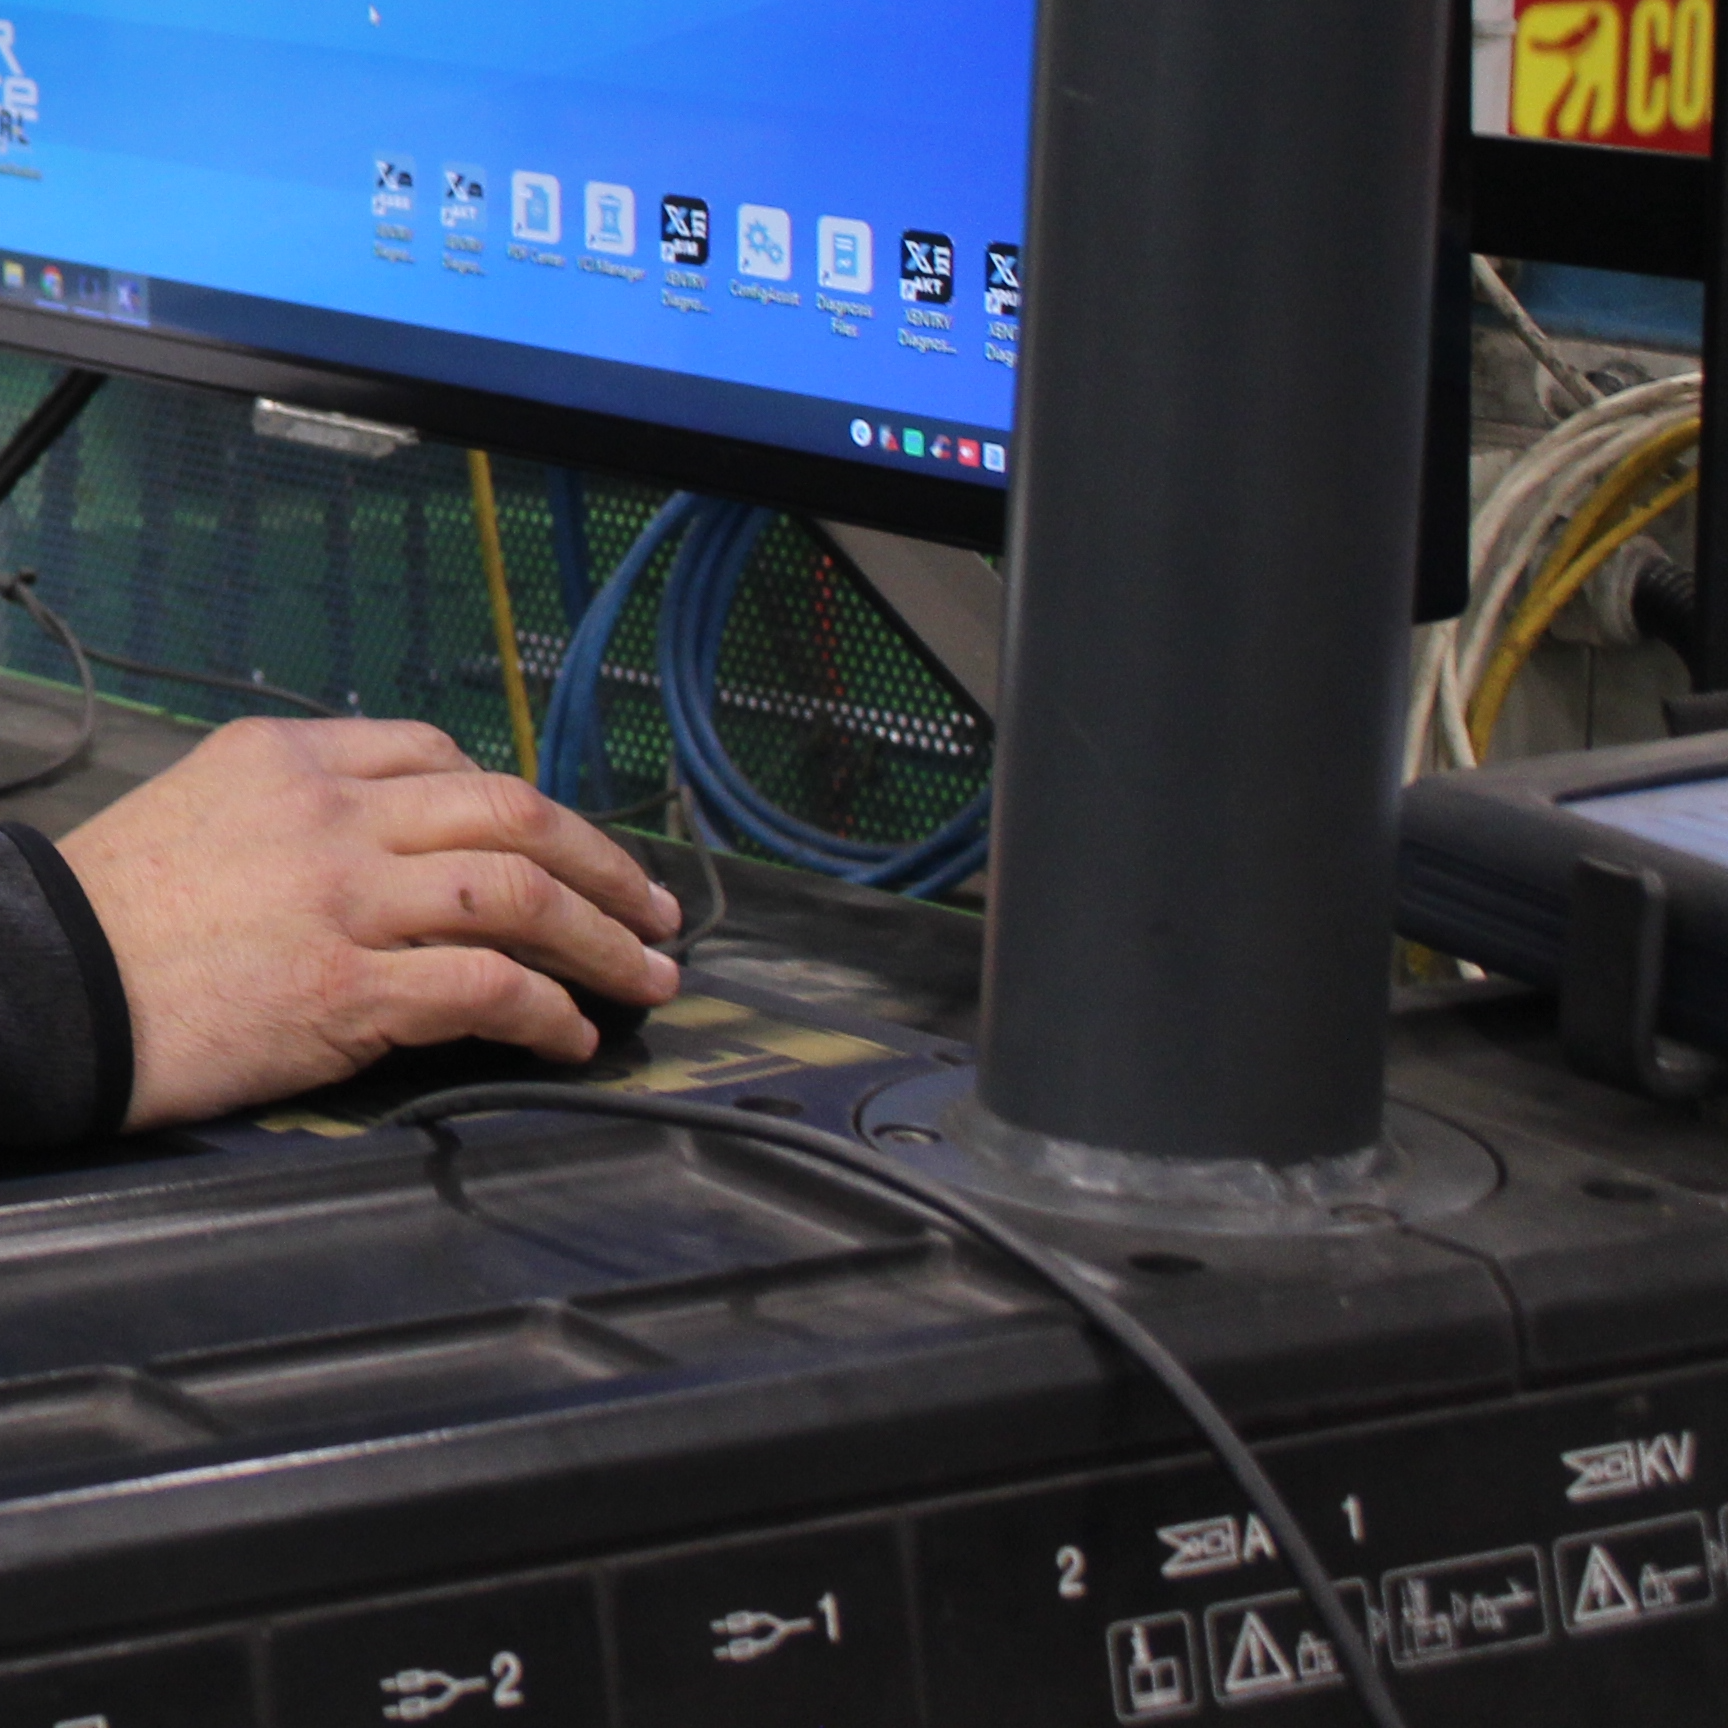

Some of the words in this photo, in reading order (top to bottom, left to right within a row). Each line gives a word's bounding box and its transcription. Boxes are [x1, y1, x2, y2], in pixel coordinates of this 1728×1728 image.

[1637, 1430, 1696, 1487] KV
[1341, 1493, 1365, 1543] 1
[1055, 1544, 1086, 1599] 2
[818, 1592, 841, 1642] 1
[490, 1649, 523, 1709] 2
